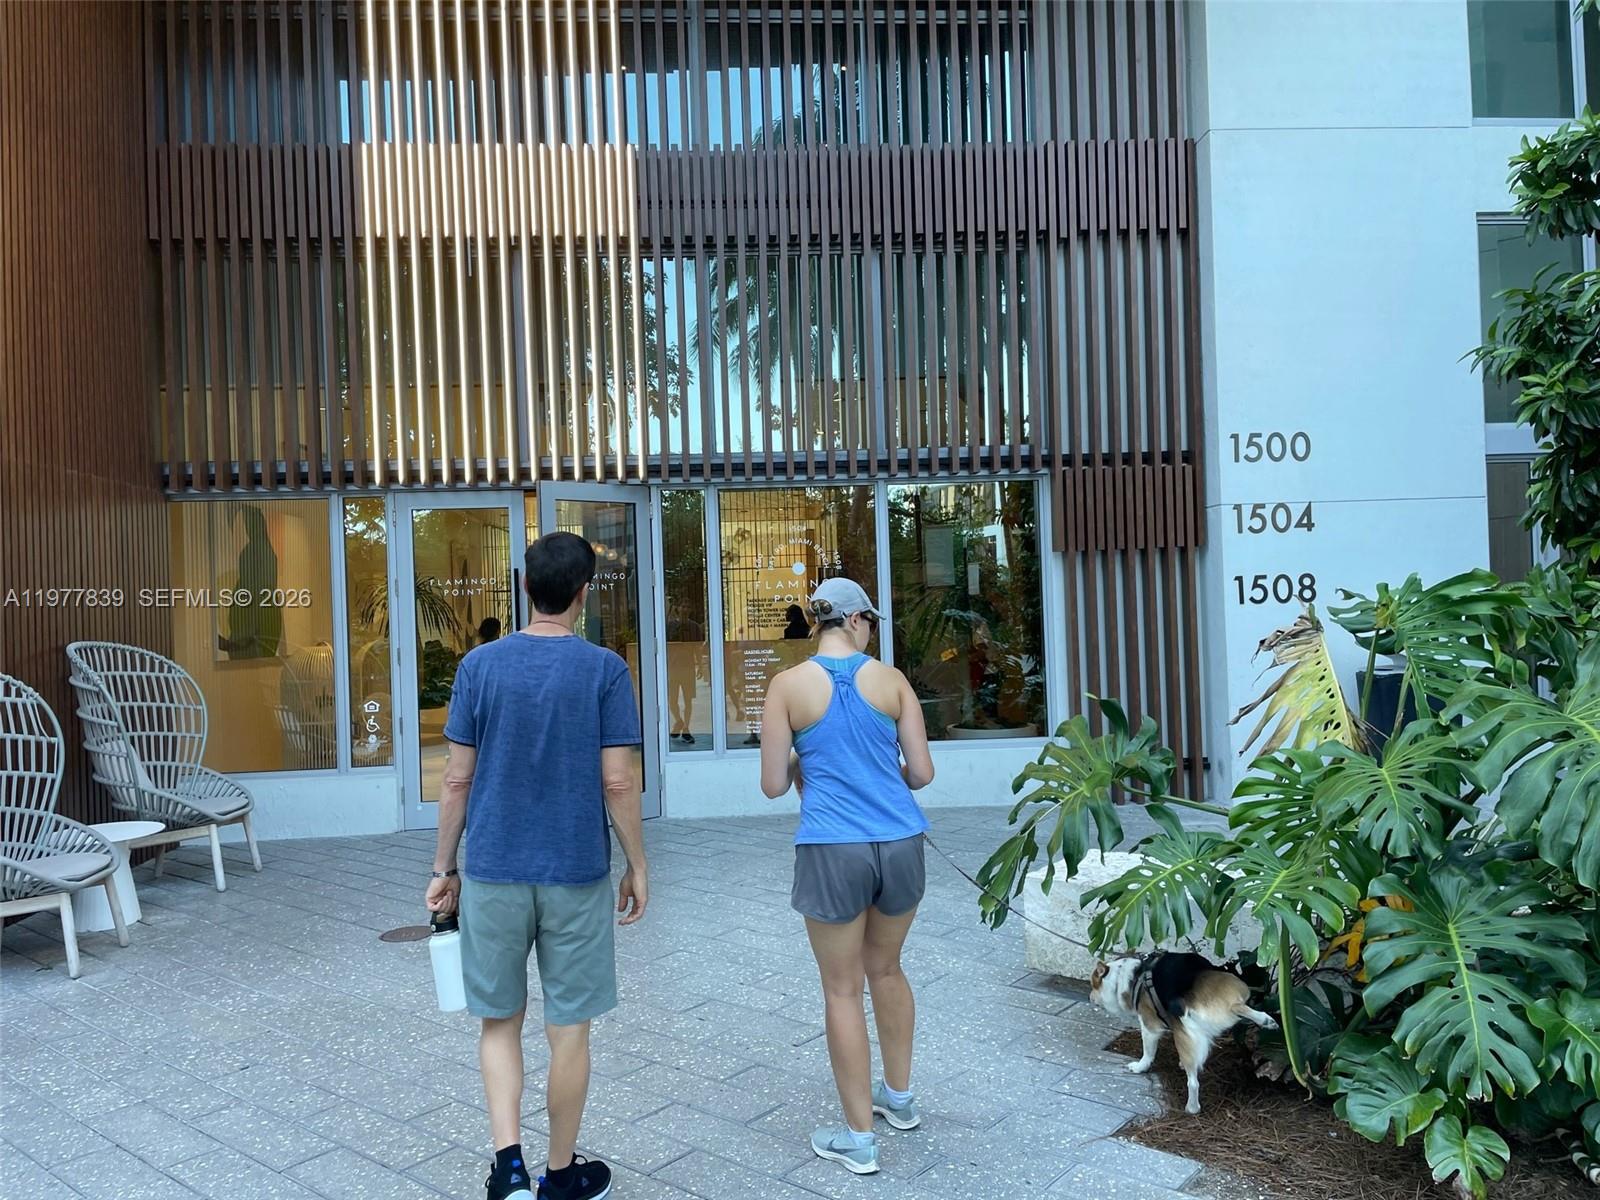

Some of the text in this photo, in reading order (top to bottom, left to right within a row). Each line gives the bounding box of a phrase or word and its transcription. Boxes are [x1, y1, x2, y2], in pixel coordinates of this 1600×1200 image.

[1229, 431, 1312, 464] 1500
[1232, 501, 1316, 535] 1504
[789, 538, 812, 546] MIAMI
[813, 543, 830, 569] BEACH
[593, 572, 626, 580] MINGO
[429, 578, 497, 586] FLAMINGO
[589, 583, 614, 591] OINT
[755, 580, 828, 591] FLAMIN
[443, 589, 482, 597] POINT
[1233, 573, 1318, 605] 1508
[774, 594, 813, 603] POIN
